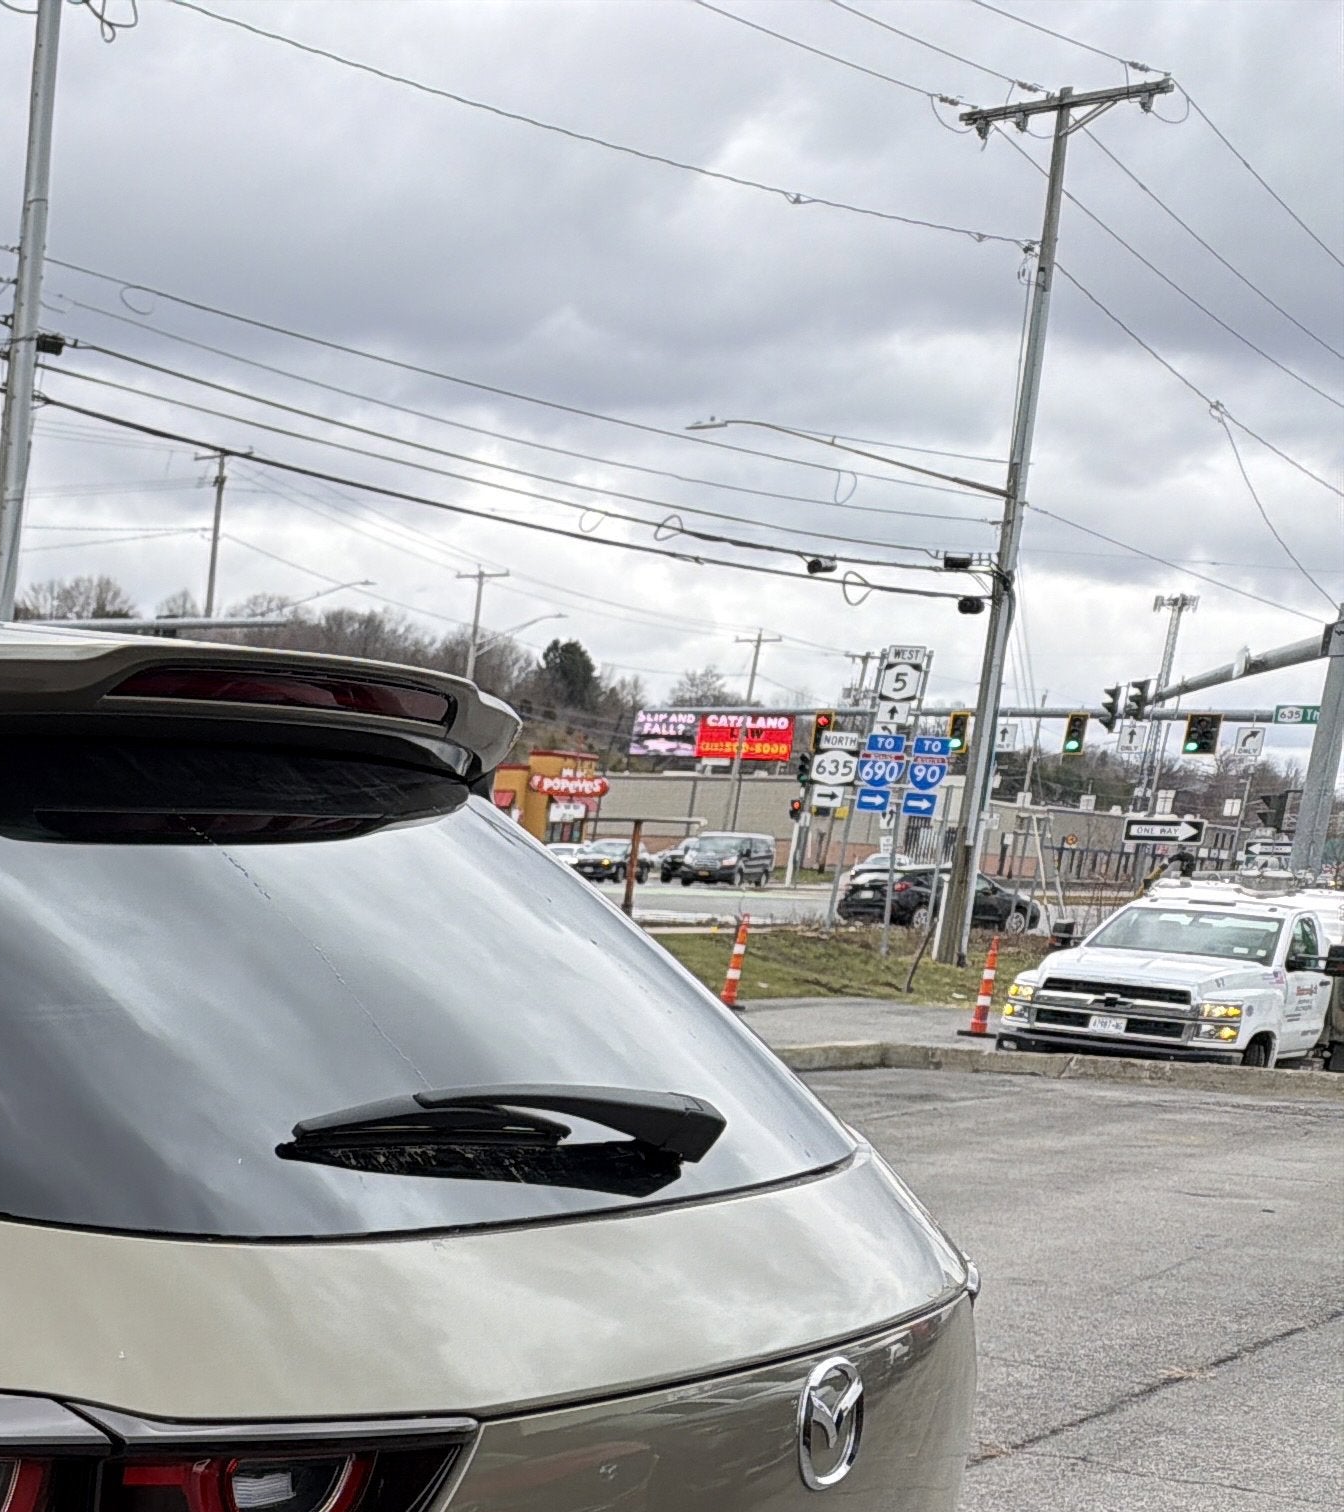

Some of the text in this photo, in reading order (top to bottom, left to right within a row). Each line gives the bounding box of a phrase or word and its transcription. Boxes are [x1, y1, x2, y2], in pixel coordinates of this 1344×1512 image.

[893, 649, 920, 661] WEST
[892, 672, 909, 692] 5
[668, 712, 696, 724] AND
[1279, 710, 1301, 720] 635
[643, 723, 686, 736] FALL?
[824, 734, 858, 747] NORTH
[877, 737, 895, 749] TO
[923, 740, 942, 752] TO
[815, 758, 854, 778] 635
[862, 761, 899, 783] 690
[914, 765, 940, 783] 90
[1136, 826, 1180, 835] ONE WAY
